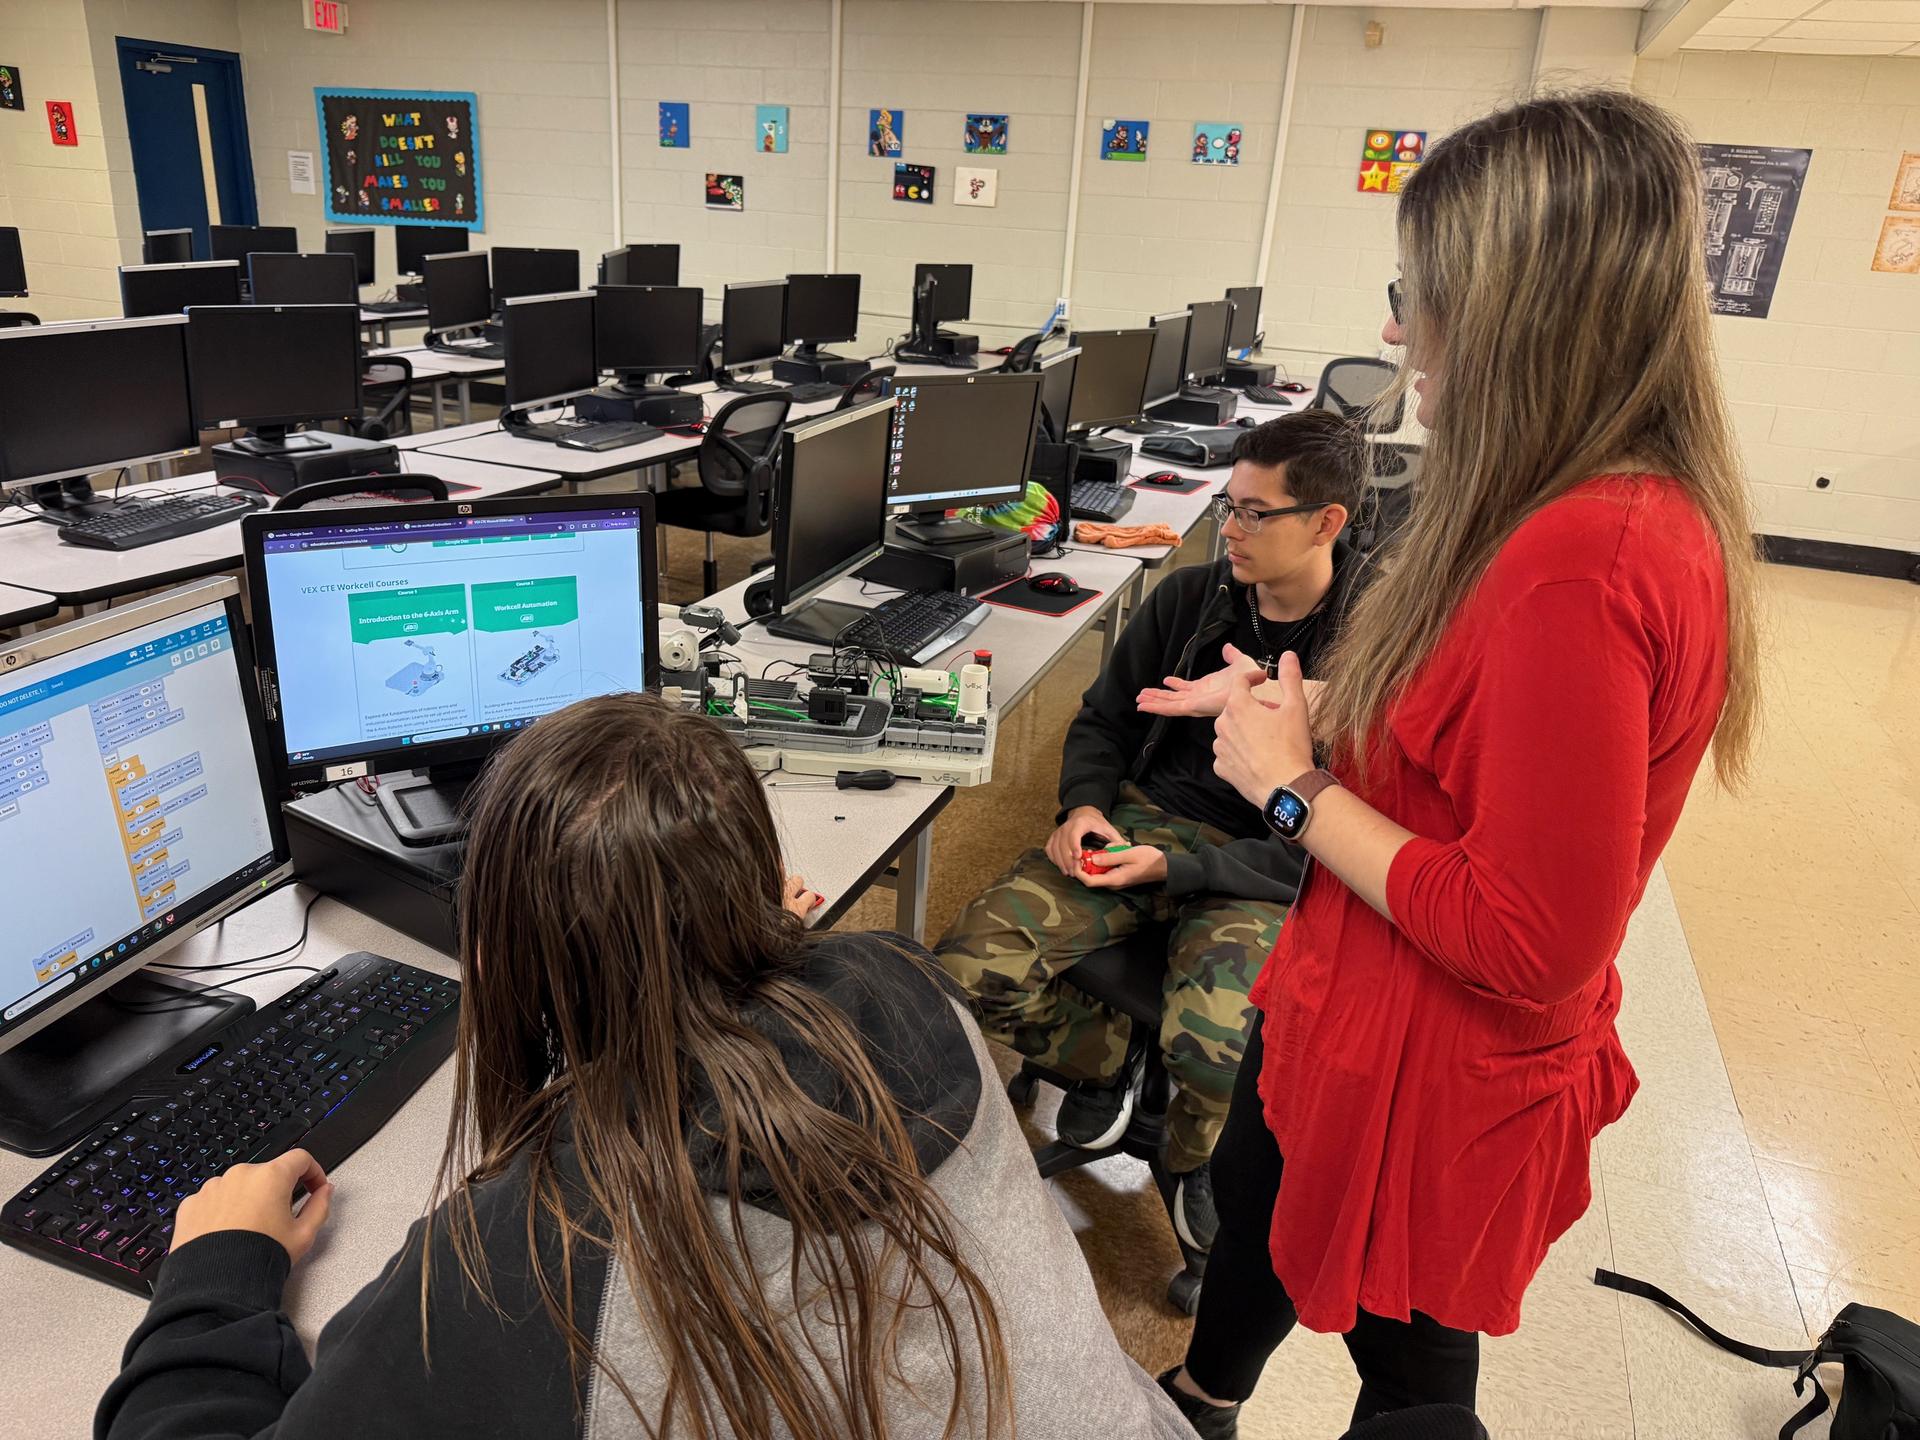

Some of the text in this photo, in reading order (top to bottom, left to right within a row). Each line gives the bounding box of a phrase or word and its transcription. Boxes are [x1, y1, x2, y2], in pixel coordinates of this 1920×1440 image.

[314, 0, 338, 31] EXIT
[382, 112, 421, 128] WHAT
[380, 135, 434, 150] DOESN'T
[375, 153, 441, 169] KILL YOU
[364, 175, 446, 191] MAKES YOU
[380, 197, 441, 212] SMALLER
[338, 581, 374, 591] Workcell
[376, 578, 408, 588] Courses
[359, 614, 401, 624] Introduction
[8, 696, 18, 705] NOT
[341, 767, 353, 776] 16
[1274, 806, 1294, 827] 9:03
